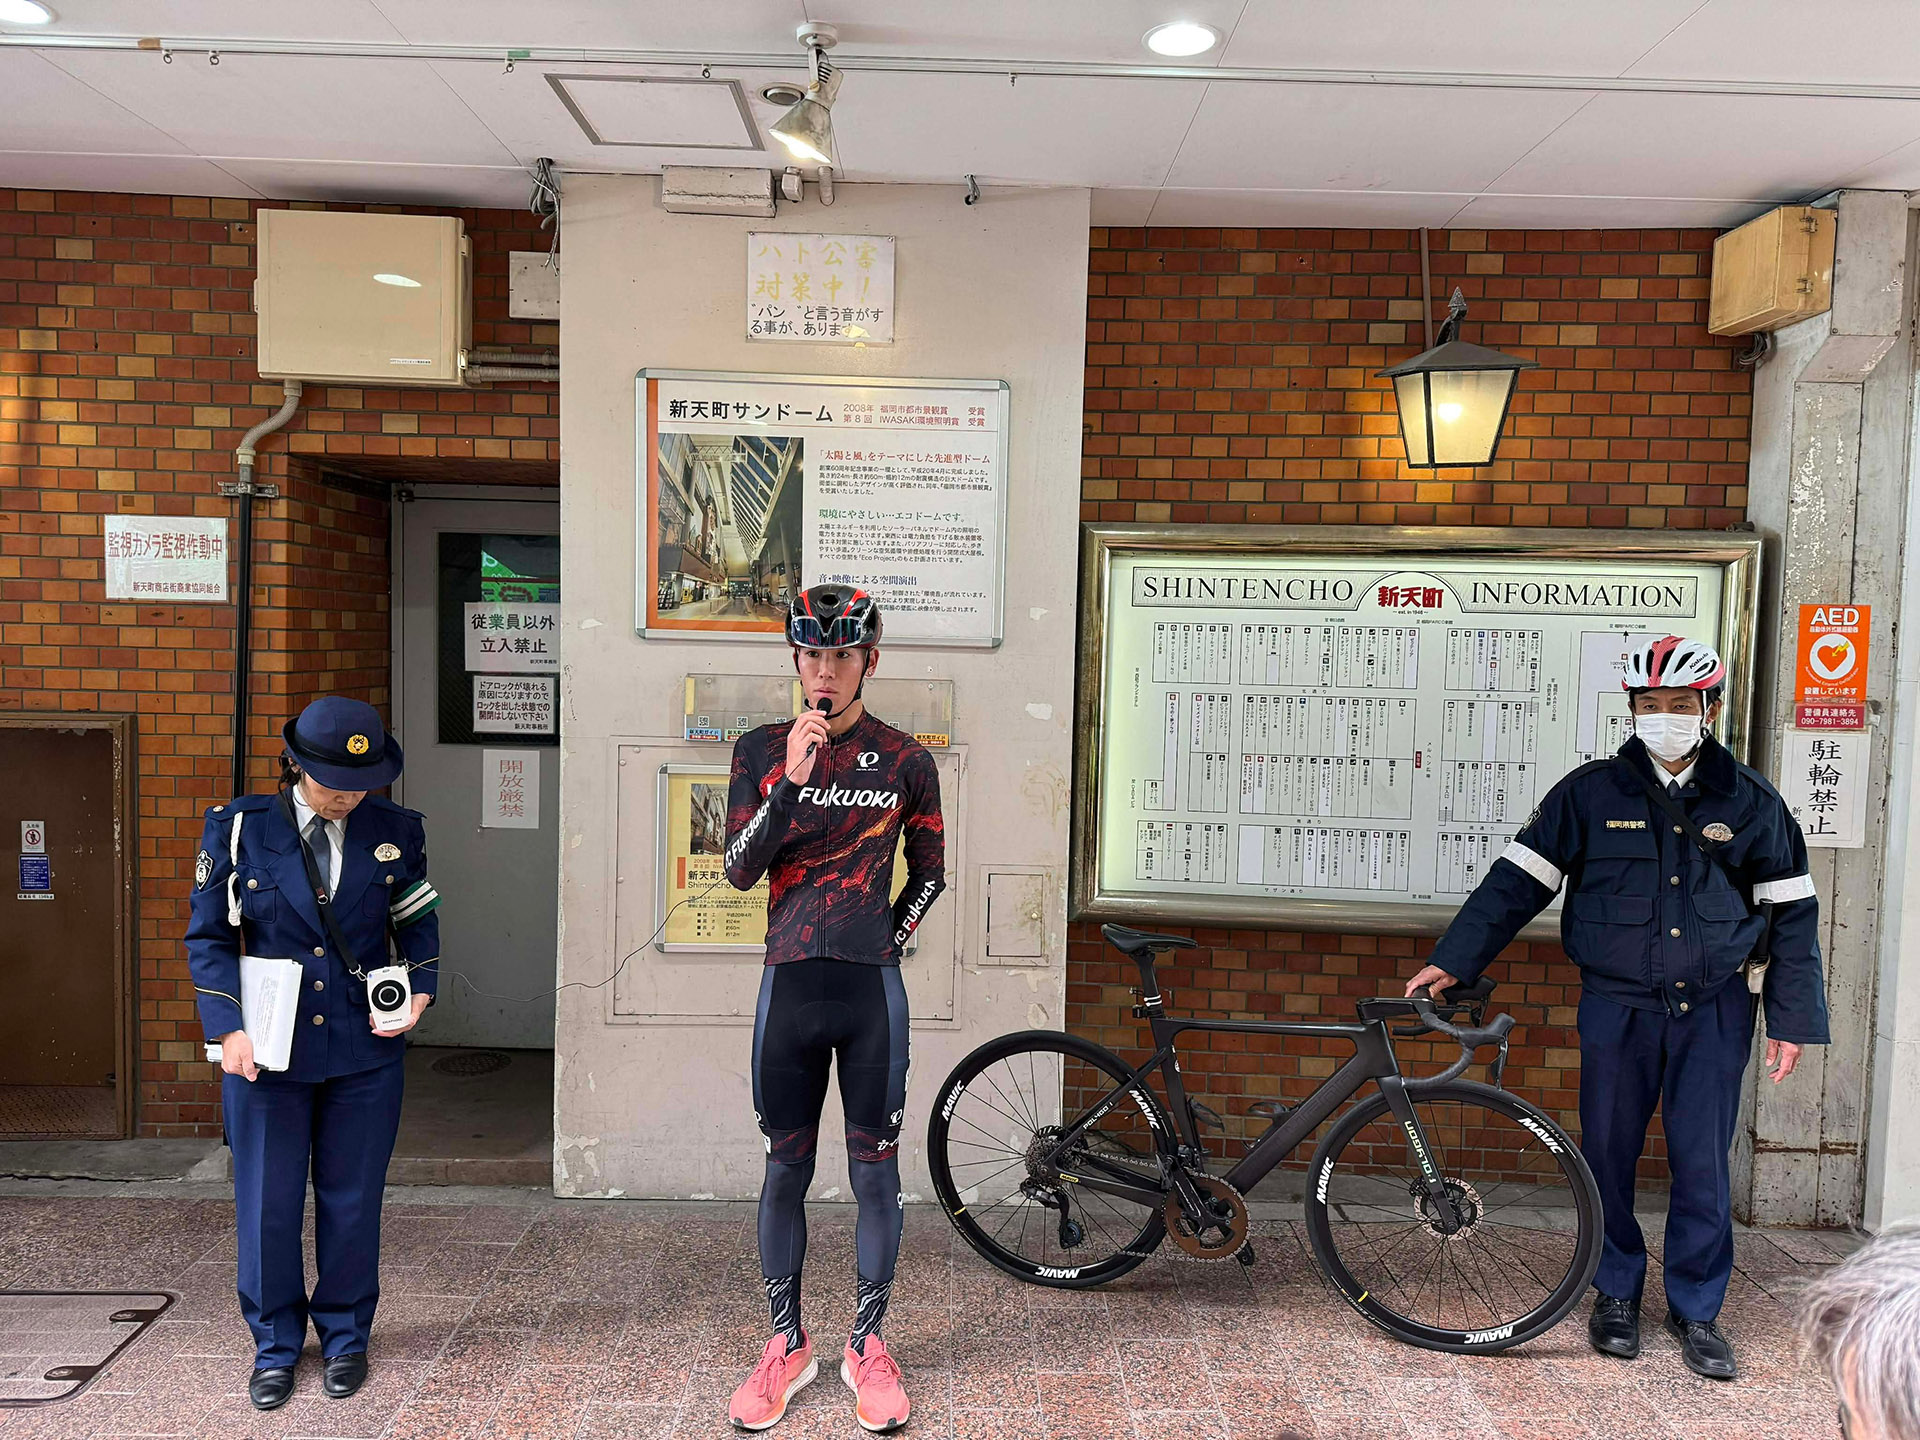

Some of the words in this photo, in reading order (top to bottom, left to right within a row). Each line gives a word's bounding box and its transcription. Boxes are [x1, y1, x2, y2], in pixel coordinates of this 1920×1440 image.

[757, 241, 878, 269] ハト公害
[669, 399, 833, 422] 新天町サンドーム
[843, 404, 874, 412] 2008年
[880, 405, 948, 415] 福岡市都市景観賞
[967, 407, 985, 416] 受賞
[967, 418, 985, 427] 受賞
[108, 531, 222, 560] 監視カメラ監視作動中
[819, 573, 918, 586] 音・映像による空間演出
[1143, 576, 1353, 601] SHINTENCHO
[1378, 586, 1444, 608] 新天町
[1472, 582, 1684, 608] INFORMATION
[471, 614, 555, 630] 従業員以外
[1810, 607, 1860, 626] AED
[480, 638, 547, 653] 立入禁止
[479, 690, 548, 700] 原因になりますので
[480, 681, 547, 691] ドアロックが壊れる
[1805, 687, 1857, 695] 設置しています
[1805, 708, 1856, 717] 警備員連絡先
[498, 760, 524, 817] 開放厳禁
[798, 780, 898, 809] FUKUOKA
[1804, 740, 1843, 835] 駐輪禁止
[1605, 820, 1646, 829] 福岡県警察
[942, 1080, 965, 1122] MAVIC
[1129, 1090, 1161, 1130] MAVIC
[1517, 1117, 1564, 1154] MAVIC
[1316, 1156, 1334, 1205] MAVIC
[1036, 1267, 1080, 1279] MAVIC
[1464, 1326, 1513, 1344] MAVIC
